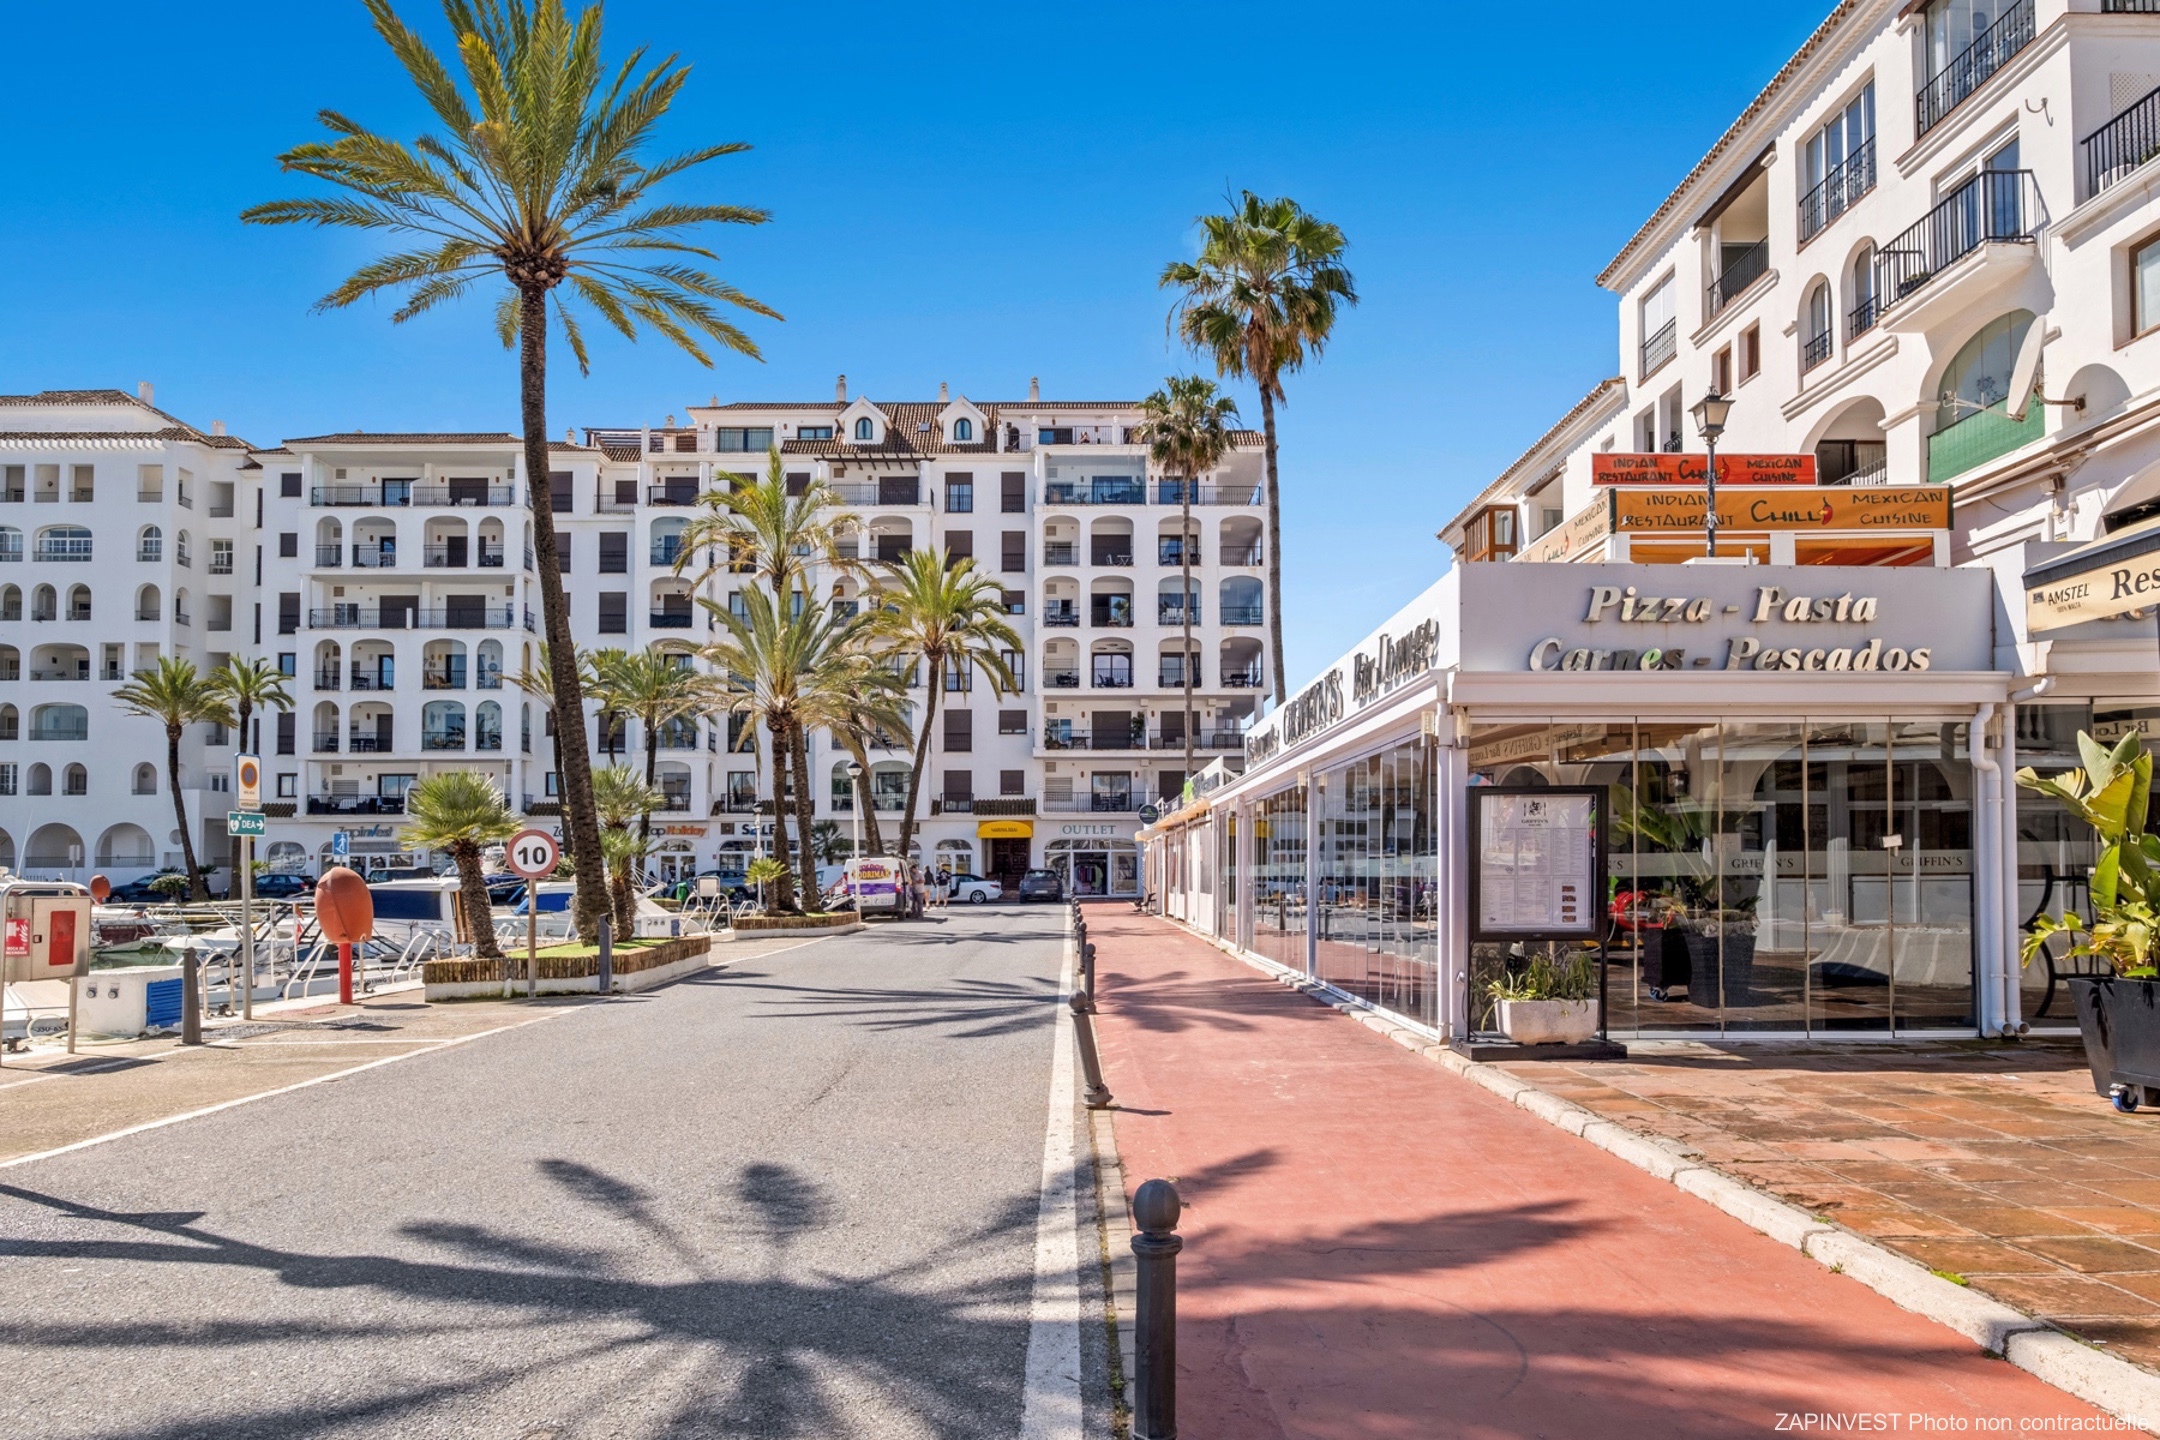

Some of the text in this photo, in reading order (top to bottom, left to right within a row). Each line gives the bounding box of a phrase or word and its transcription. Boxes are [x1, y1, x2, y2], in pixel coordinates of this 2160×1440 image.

[1613, 457, 1658, 468] INDIAN
[1747, 457, 1803, 469] MEXICAN
[1598, 471, 1673, 482] RESTAURANT
[1752, 471, 1798, 482] CUISINE
[1647, 494, 1707, 506] INDIAN
[1852, 491, 1943, 504] MEXICAN
[1574, 498, 1608, 530] MEXICAN
[1860, 513, 1932, 525] CUISINE
[1626, 514, 1734, 527] RESTAURANT
[2047, 582, 2090, 606] AMSTEL
[1583, 586, 1713, 623] Pizza
[1751, 586, 1878, 623] Pasta
[1528, 637, 1686, 672] Carnes
[1725, 636, 1932, 672] Pescados
[241, 820, 256, 829] DEA
[1062, 825, 1116, 835] OUTLET
[648, 825, 707, 838] ap Holiday
[517, 846, 547, 866] 10
[1731, 858, 1794, 869] GRIFN'S
